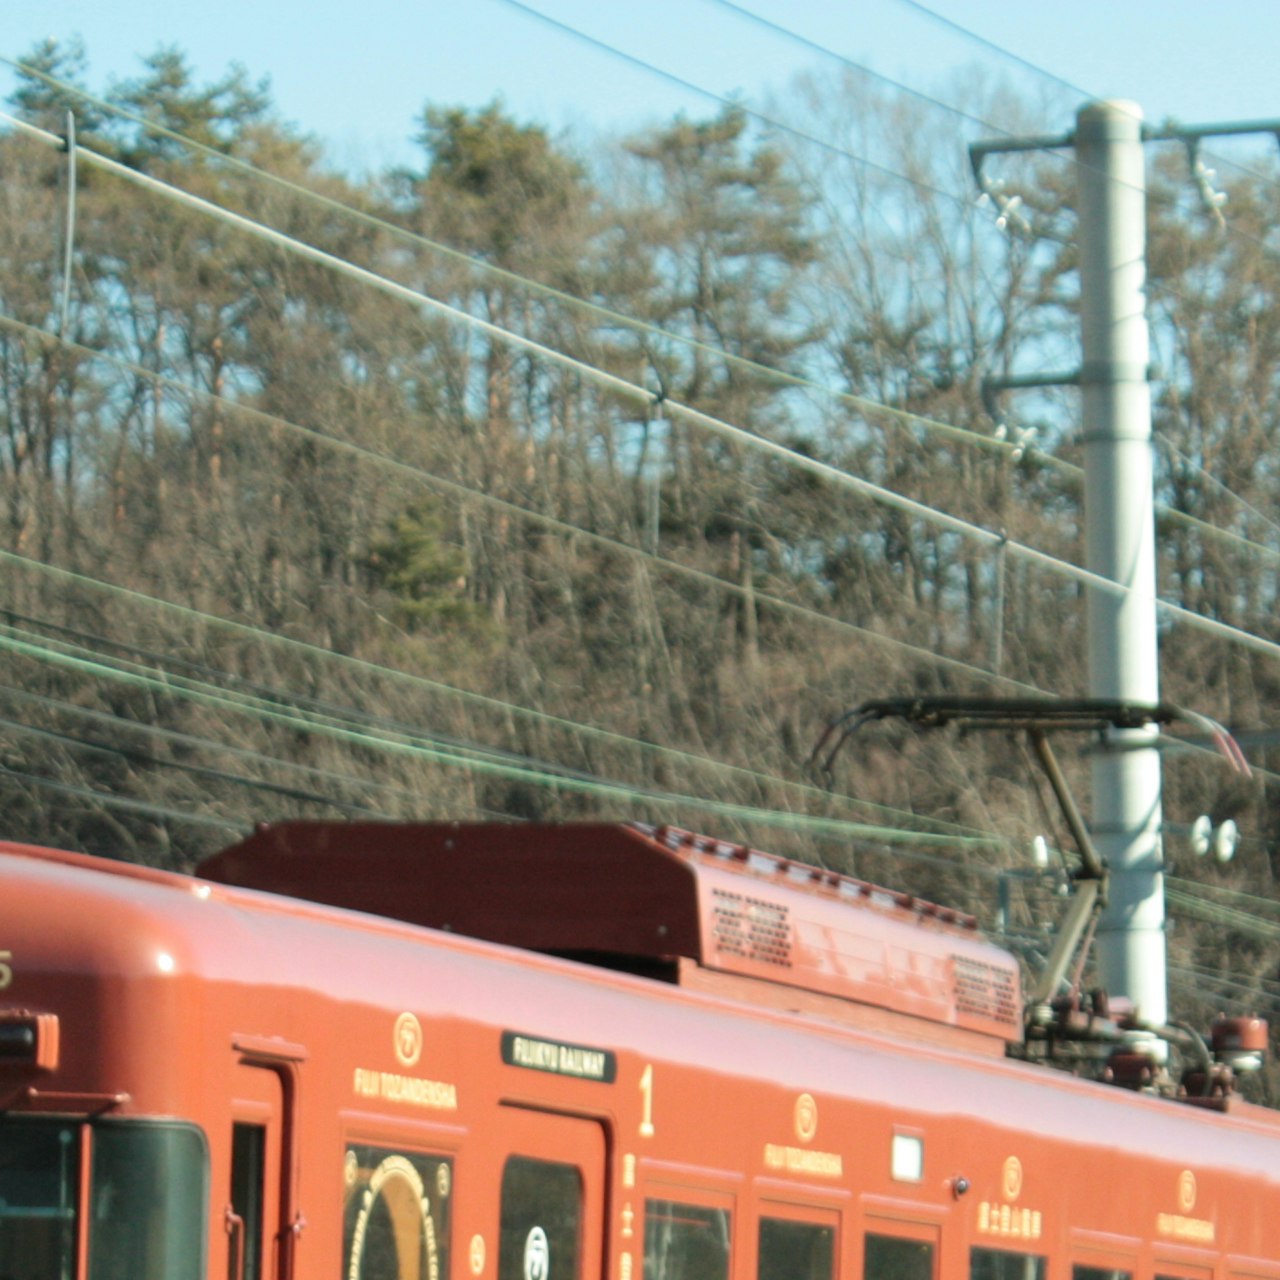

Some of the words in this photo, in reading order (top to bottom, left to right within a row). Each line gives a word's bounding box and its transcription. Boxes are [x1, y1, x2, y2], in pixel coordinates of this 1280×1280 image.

[513, 1036, 558, 1072] FUJIKYU
[559, 1046, 605, 1079] RAILWAY
[354, 1067, 380, 1097] FUJI
[638, 1064, 654, 1137] 1
